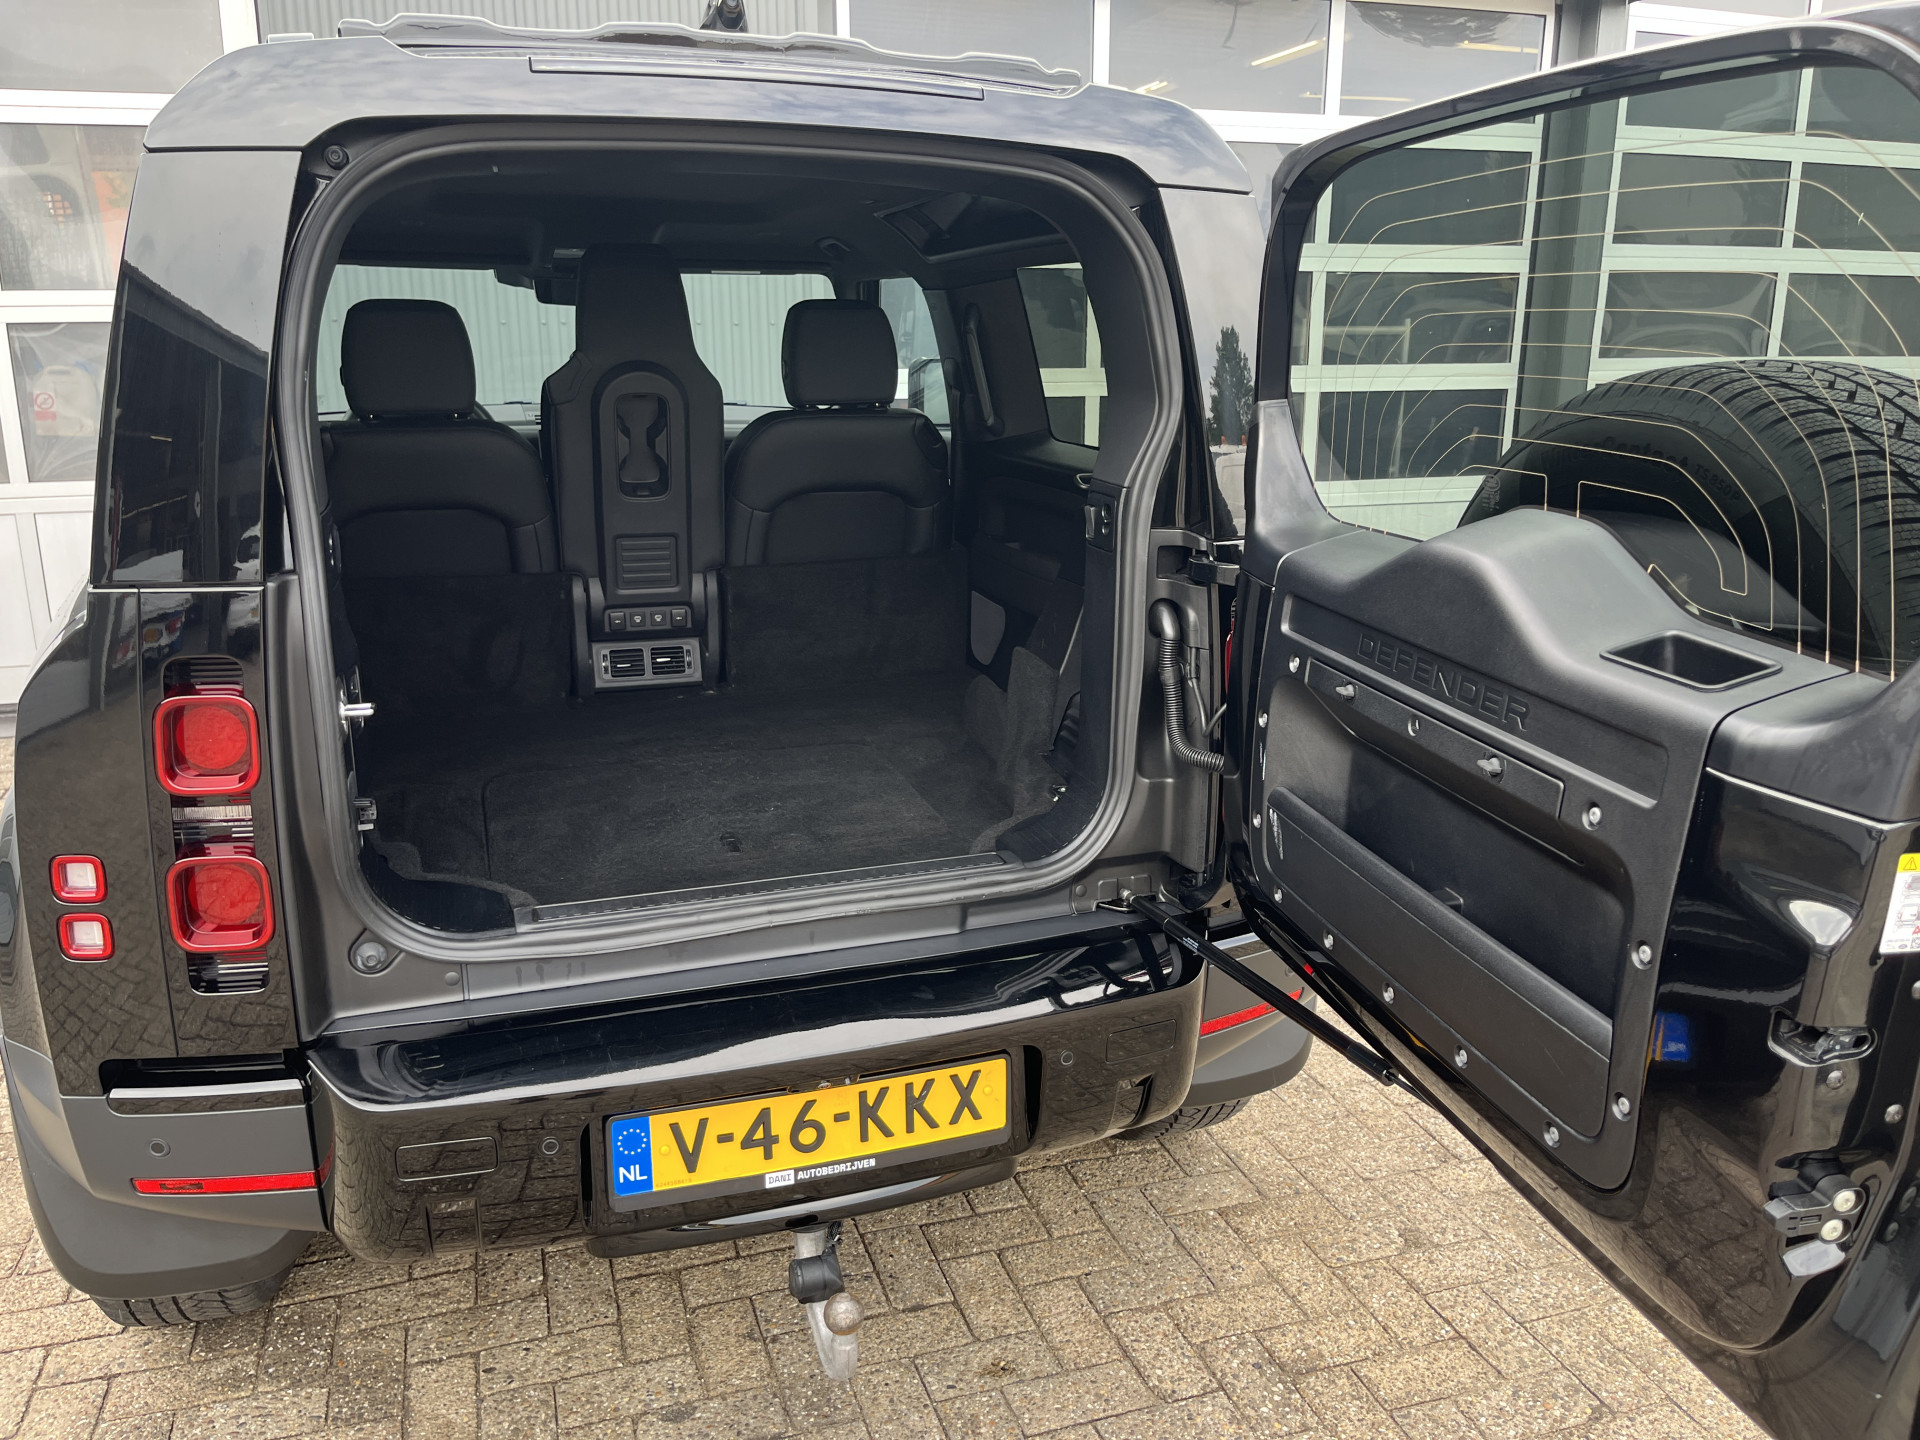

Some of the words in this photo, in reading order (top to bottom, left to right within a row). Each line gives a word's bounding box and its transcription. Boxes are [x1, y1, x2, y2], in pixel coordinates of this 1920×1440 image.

[1357, 633, 1530, 731] DEFENDER
[669, 1069, 982, 1174] V-46-KKX
[618, 1164, 647, 1184] NL
[768, 1173, 792, 1185] DANI
[797, 1158, 876, 1180] AUTOBEDRIJVEN
